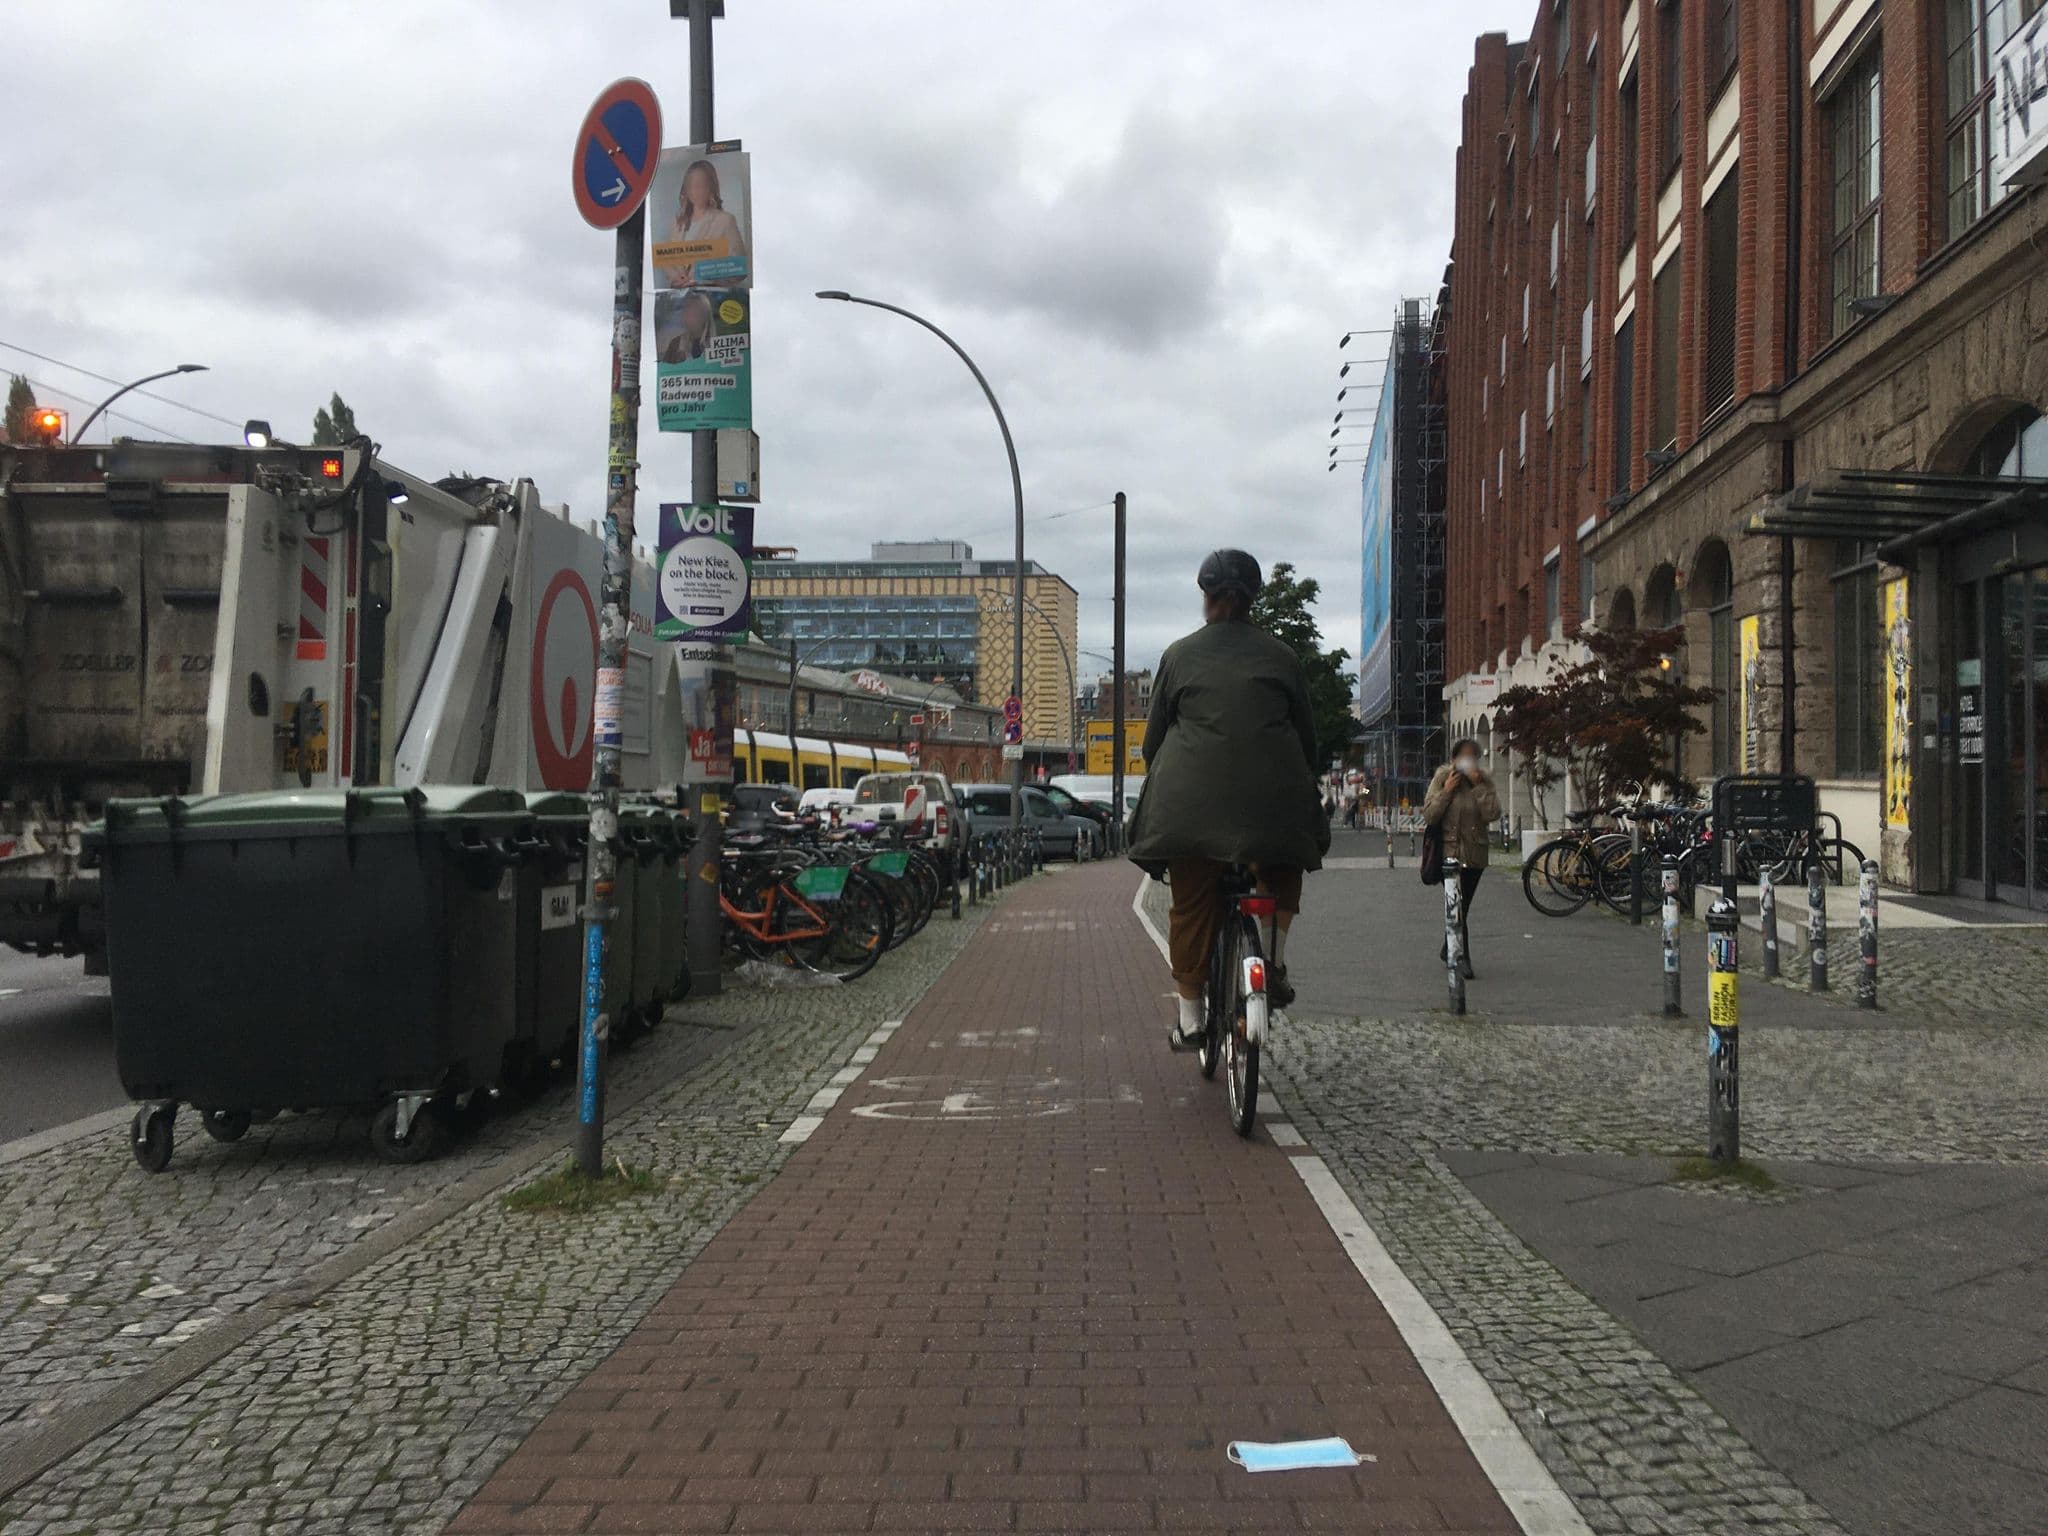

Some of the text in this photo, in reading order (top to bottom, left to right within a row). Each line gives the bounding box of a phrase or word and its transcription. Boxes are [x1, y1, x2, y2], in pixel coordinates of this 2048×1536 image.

[2001, 10, 2048, 158] NE
[713, 336, 745, 348] KLIMA
[709, 348, 736, 360] LISTE
[661, 376, 734, 388] 365 km neue
[661, 390, 712, 402] Radwege
[661, 402, 706, 417] pro Jahr
[676, 506, 735, 535] Volt
[678, 556, 729, 567] New Kiez
[670, 569, 683, 578] on
[684, 568, 703, 578] the
[58, 653, 136, 673] ZOELLER
[1720, 983, 1729, 1022] FASHION
